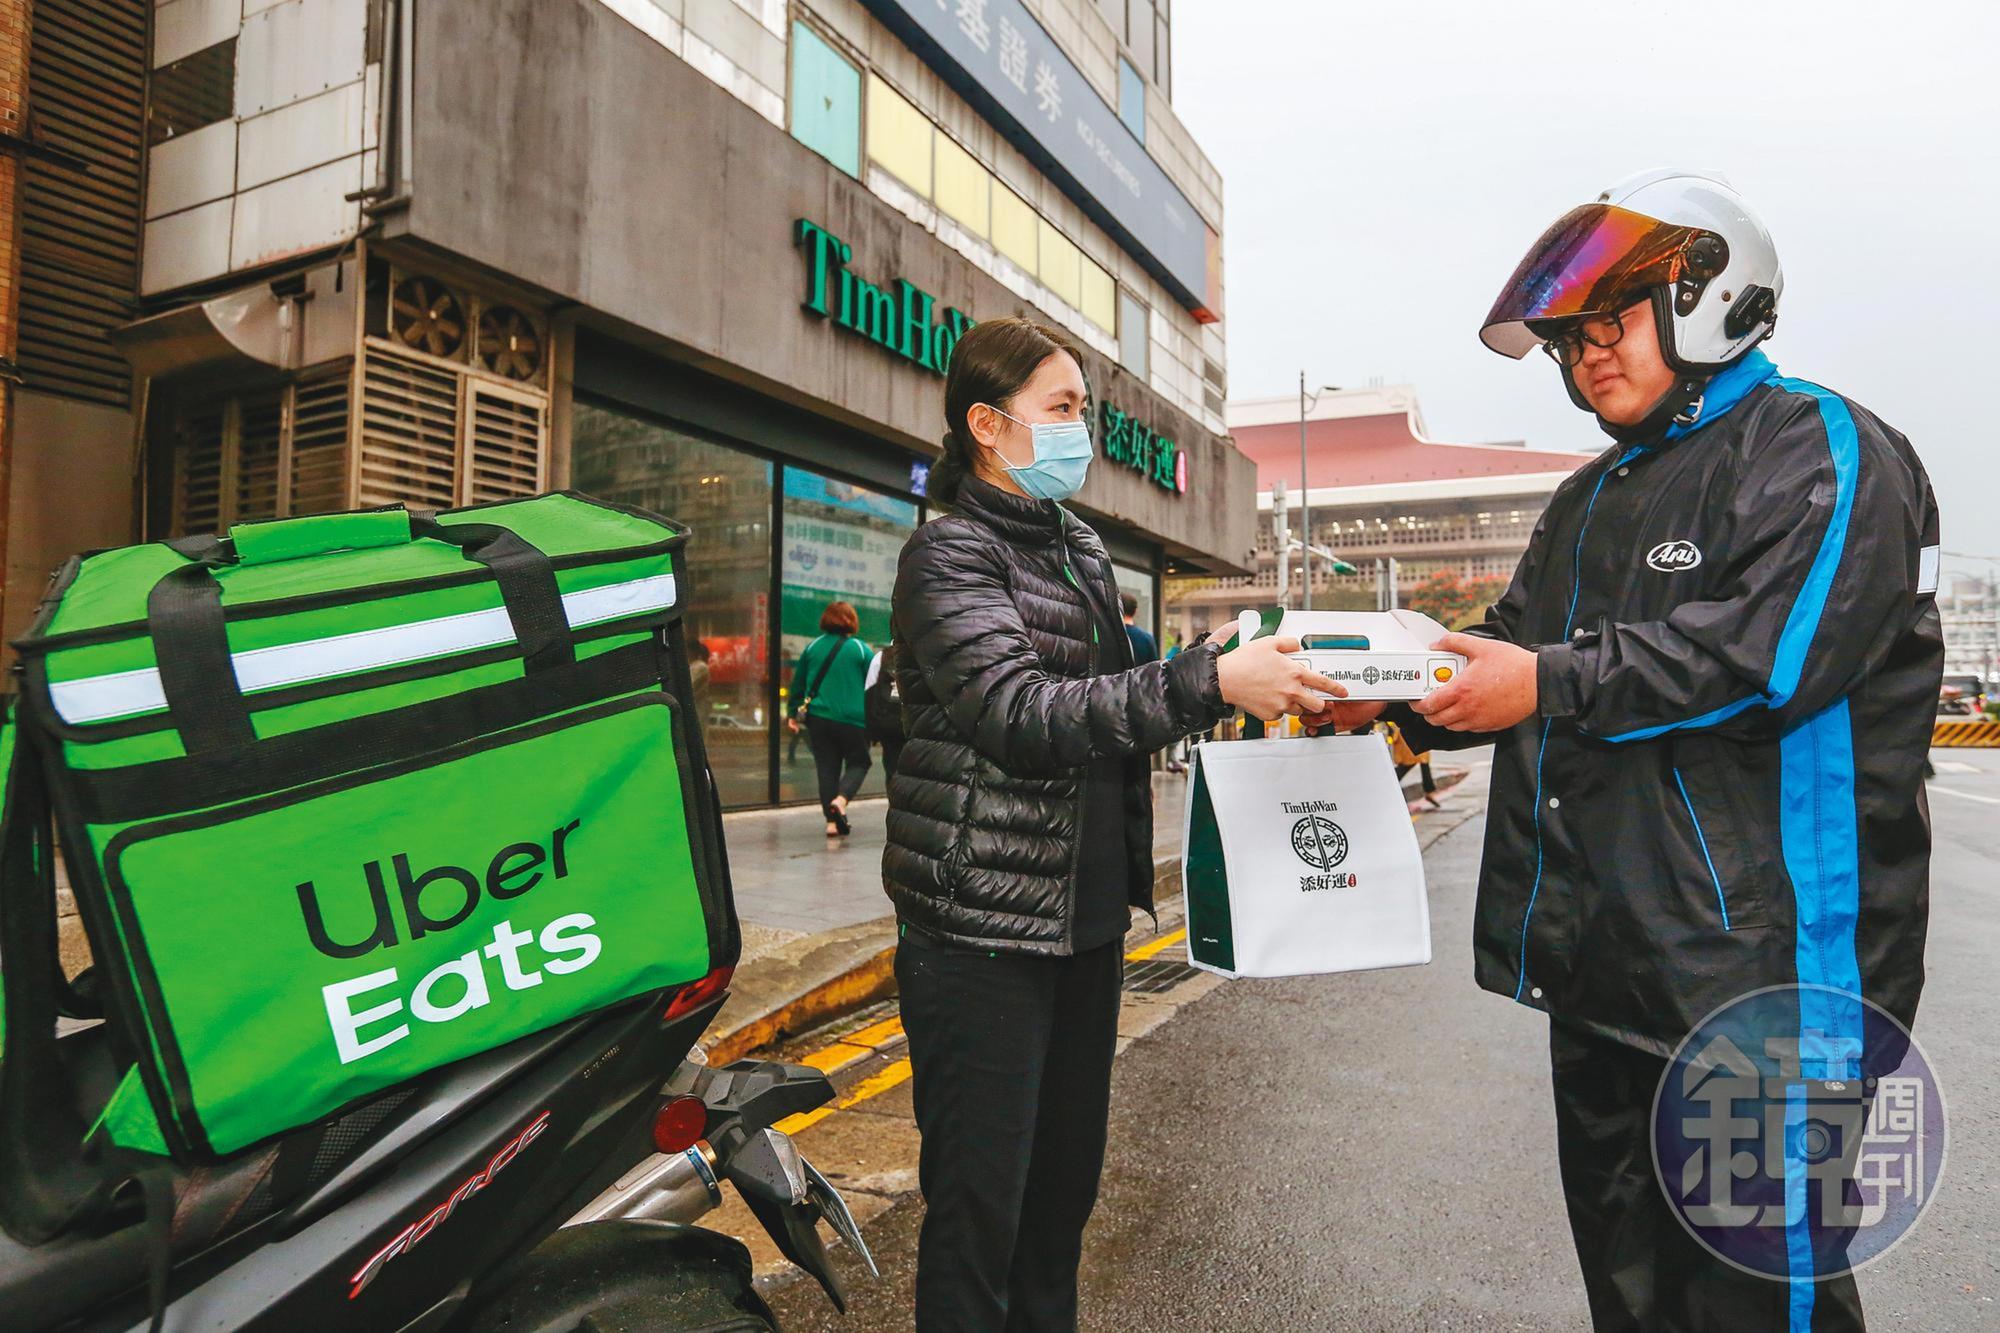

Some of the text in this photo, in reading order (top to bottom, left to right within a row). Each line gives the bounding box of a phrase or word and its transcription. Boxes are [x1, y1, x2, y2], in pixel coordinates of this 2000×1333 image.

[936, 0, 1061, 122] 基證券
[1101, 402, 1175, 490] 添好運
[1381, 669, 1414, 681] 添好運
[1281, 800, 1337, 813] TimHoWan
[295, 818, 580, 959] Uber
[1300, 873, 1347, 892] 添好運
[322, 913, 602, 1065] Eats
